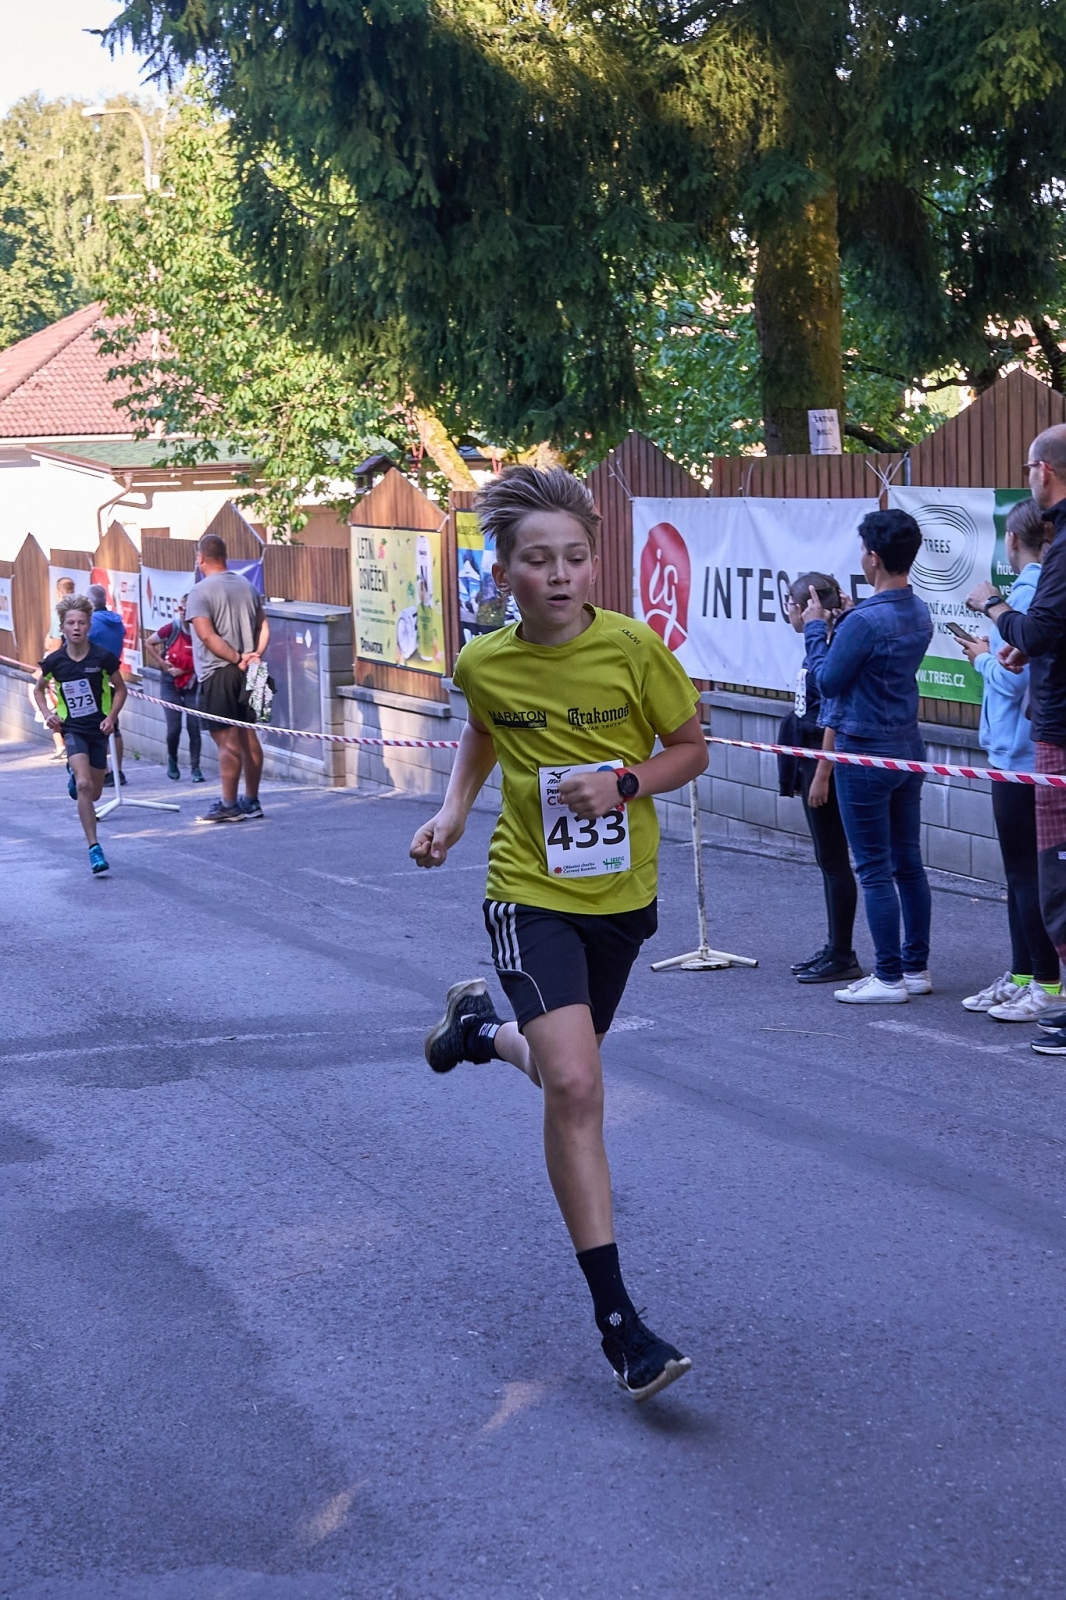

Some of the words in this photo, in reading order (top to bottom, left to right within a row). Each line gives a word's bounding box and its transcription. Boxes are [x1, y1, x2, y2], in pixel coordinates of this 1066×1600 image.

[923, 539, 951, 554] TREES
[67, 694, 94, 709] 373
[488, 710, 546, 722] MARATON
[547, 810, 626, 851] 433
